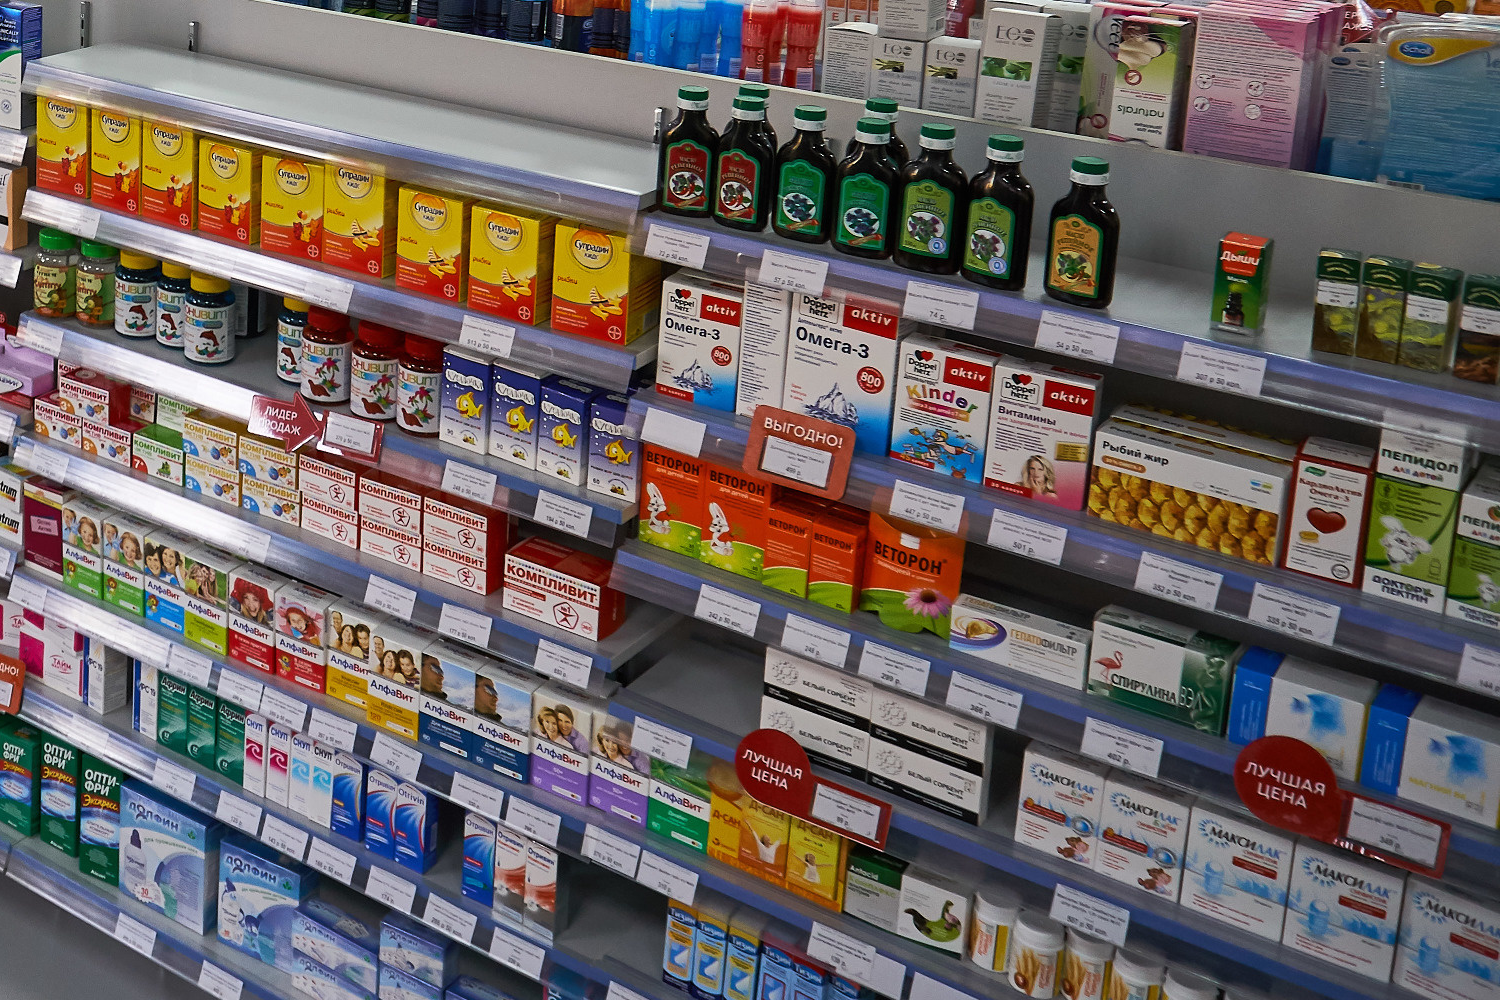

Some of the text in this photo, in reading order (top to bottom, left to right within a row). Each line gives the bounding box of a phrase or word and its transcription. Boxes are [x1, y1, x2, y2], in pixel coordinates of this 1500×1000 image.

[338, 167, 372, 186] Супрадин
[414, 201, 444, 218] Супрадин
[488, 222, 520, 239] Супрадин
[574, 238, 611, 258] Супрадин
[1220, 250, 1260, 266] Дыши
[706, 305, 737, 317] aktiv
[809, 307, 828, 318] herz
[665, 317, 720, 341] Омега-3
[795, 325, 870, 360] Омега-3
[713, 350, 730, 361] 800
[908, 357, 937, 371] Doppel
[951, 368, 986, 381] aktiv
[906, 384, 978, 412] Kinder
[1050, 391, 1088, 405] aktiv
[265, 405, 298, 421] ЛИДЕР
[998, 406, 1056, 426] Витамины
[764, 417, 844, 449] ВЫГОДНО!
[646, 451, 700, 476] ВЕТОРОН
[1102, 440, 1169, 466] Рыбий жир
[1381, 448, 1459, 474] ПЕПИДОЛ
[300, 459, 354, 484] КОМПЛИВИТ
[709, 469, 766, 497] ВЕТОРОН
[360, 482, 420, 508] КОМПЛИВИТ
[425, 501, 486, 529] КОМПЛИВИТ
[424, 540, 485, 568] КОМПЛИВИТ
[874, 541, 942, 575] ВЕТОРОН
[506, 564, 598, 602] КОМПЛИВИТ
[1010, 628, 1078, 657] ГЕПАТОФИЛЬТР
[161, 676, 187, 694] Африн
[371, 679, 414, 704] АлфаВит
[1110, 673, 1177, 702] СПИРУЛИНА
[424, 701, 467, 724] АлфаВит
[478, 722, 521, 748] АлфаВит
[313, 746, 333, 762] СНУП
[536, 742, 581, 768] АлфаВит
[742, 749, 803, 780] ЛУЧШАЯ
[84, 769, 120, 787] ОПТИ-
[84, 781, 110, 797] ФРИ
[751, 767, 789, 790] ЦЕНА
[1244, 762, 1326, 796] ЛУЧШАЯ
[398, 788, 425, 806] Otrivin
[654, 785, 704, 814] АлфаВит
[1257, 782, 1307, 809] ЦЕНА
[712, 809, 741, 827] Д-САН
[1210, 826, 1281, 859] МАКСИЛАК
[1314, 865, 1390, 899] МАКСИЛАК
